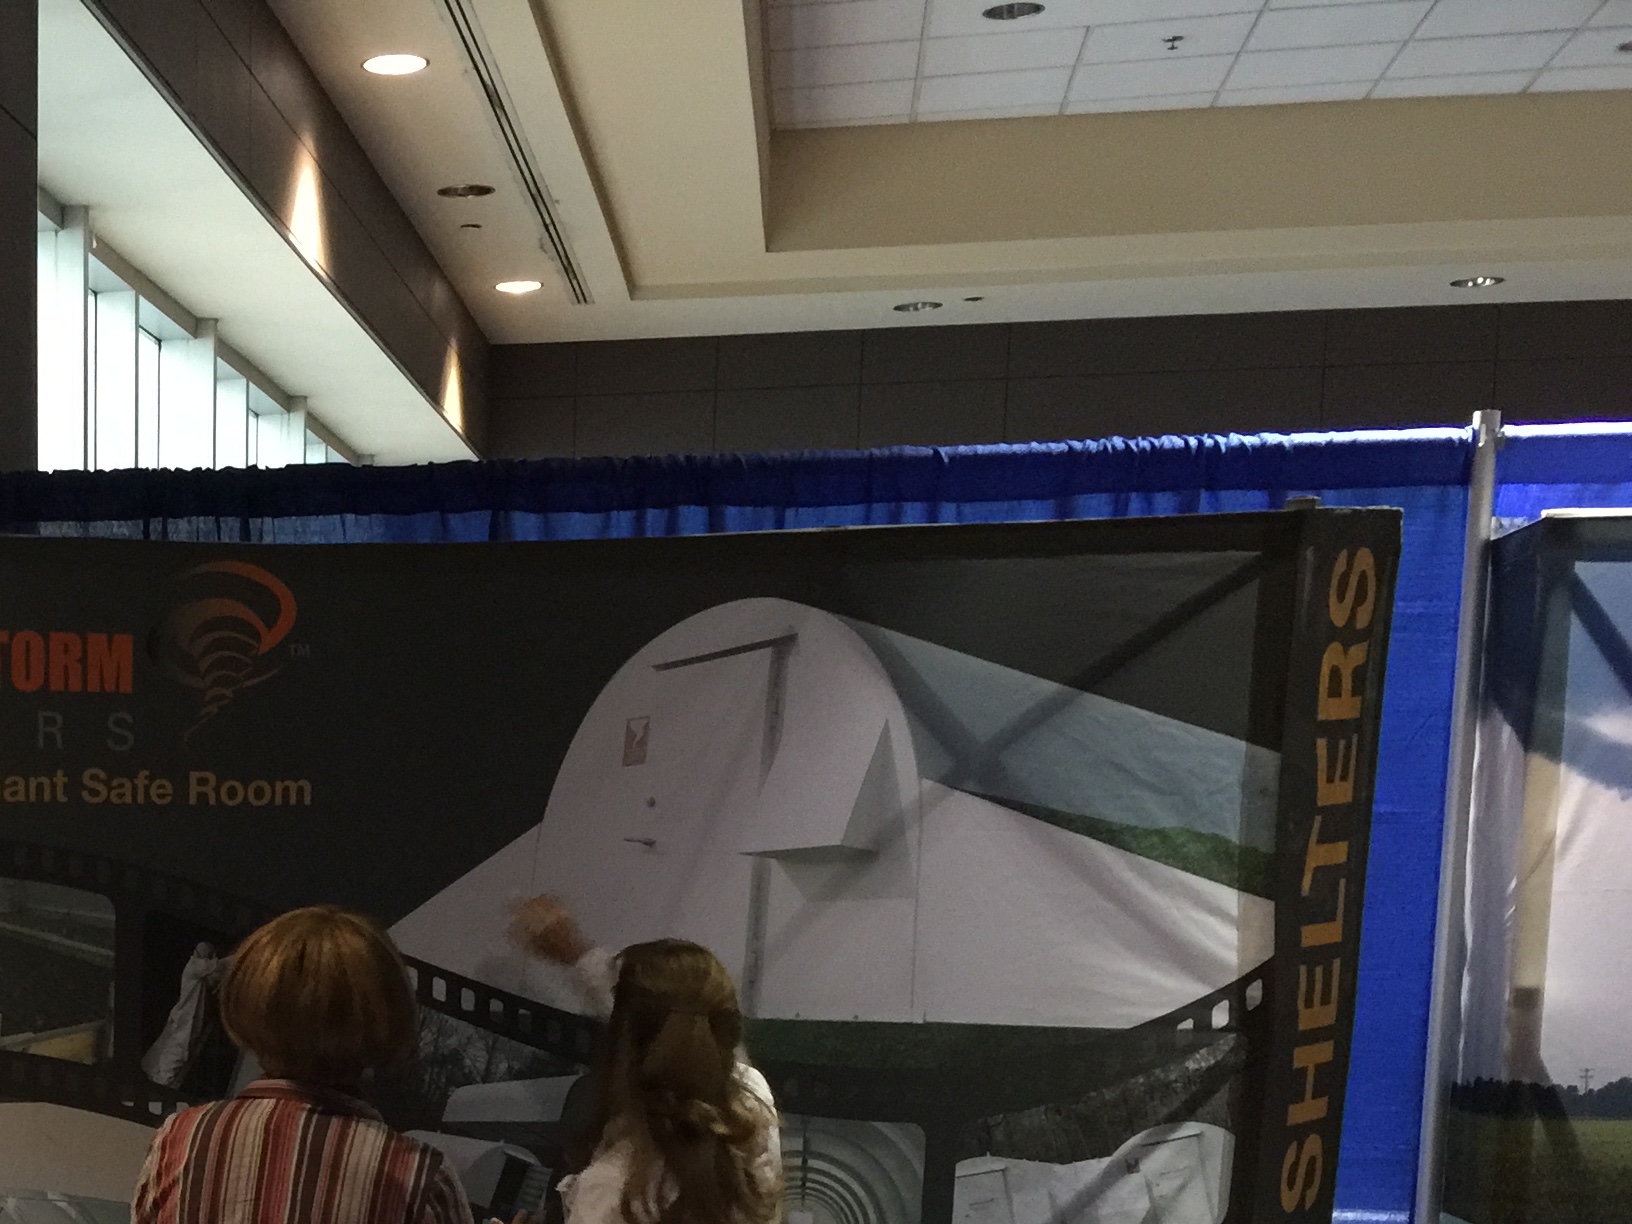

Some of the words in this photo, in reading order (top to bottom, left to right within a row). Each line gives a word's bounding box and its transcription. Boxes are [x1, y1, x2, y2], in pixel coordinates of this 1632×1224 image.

[81, 769, 173, 805] Safe
[188, 772, 312, 806] Room
[1279, 545, 1379, 1214] SHELTERS
